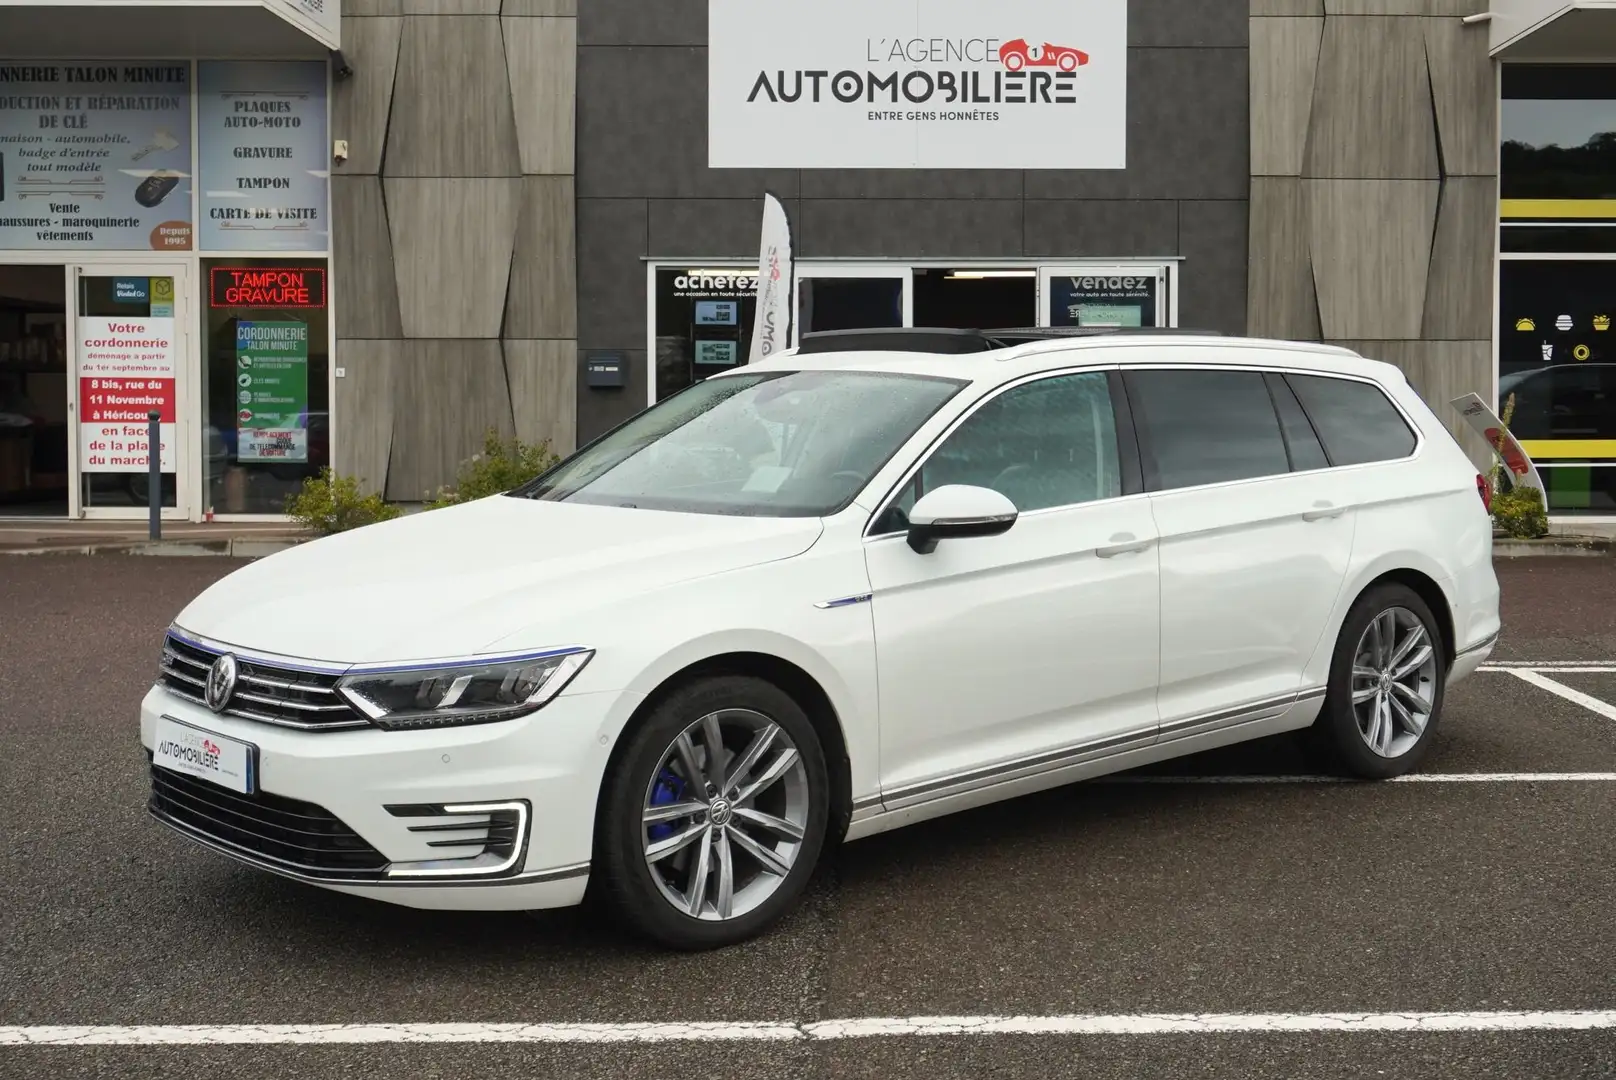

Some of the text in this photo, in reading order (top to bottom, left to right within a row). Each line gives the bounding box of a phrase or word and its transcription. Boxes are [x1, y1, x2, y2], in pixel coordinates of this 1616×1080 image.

[65, 67, 118, 82] TALON
[124, 67, 184, 82] MINUTE
[65, 97, 82, 110] ET
[87, 95, 180, 110] RÉPARATION
[234, 101, 291, 113] PLAQUES
[39, 112, 88, 128] DE CLÉ
[868, 109, 999, 121] ENTRE GENS HONNÊTES
[224, 116, 301, 128] AUTO-MOTO
[18, 148, 110, 160] badge d'entrée
[233, 147, 292, 158] GRAVURE
[27, 162, 101, 172] tout modèle
[236, 177, 290, 189] TAMPON
[49, 203, 80, 213] Vente
[210, 208, 317, 219] CARTE DE VISITE
[0, 218, 50, 227] aussures
[62, 217, 139, 228] maroquinerie
[37, 230, 93, 241] vêtements
[160, 227, 191, 237] Depuis
[231, 272, 304, 287] TAMPON
[674, 270, 759, 289] achetez
[1070, 277, 1147, 289] vendez
[225, 288, 309, 303] GRAVURE
[108, 323, 145, 333] Votre
[237, 327, 306, 340] CORDONNERIE
[85, 338, 168, 348] cordonnerie
[247, 341, 297, 350] TALON MINUTE
[141, 353, 166, 361] partir
[112, 364, 157, 373] septembre
[91, 380, 99, 388] 8
[102, 380, 122, 390] bis,
[148, 380, 162, 388] du
[89, 395, 164, 405] 11 Novembre
[93, 409, 160, 420] à Héricou,
[123, 426, 149, 435] face
[89, 441, 165, 452] de la plae
[89, 456, 166, 465] du march.
